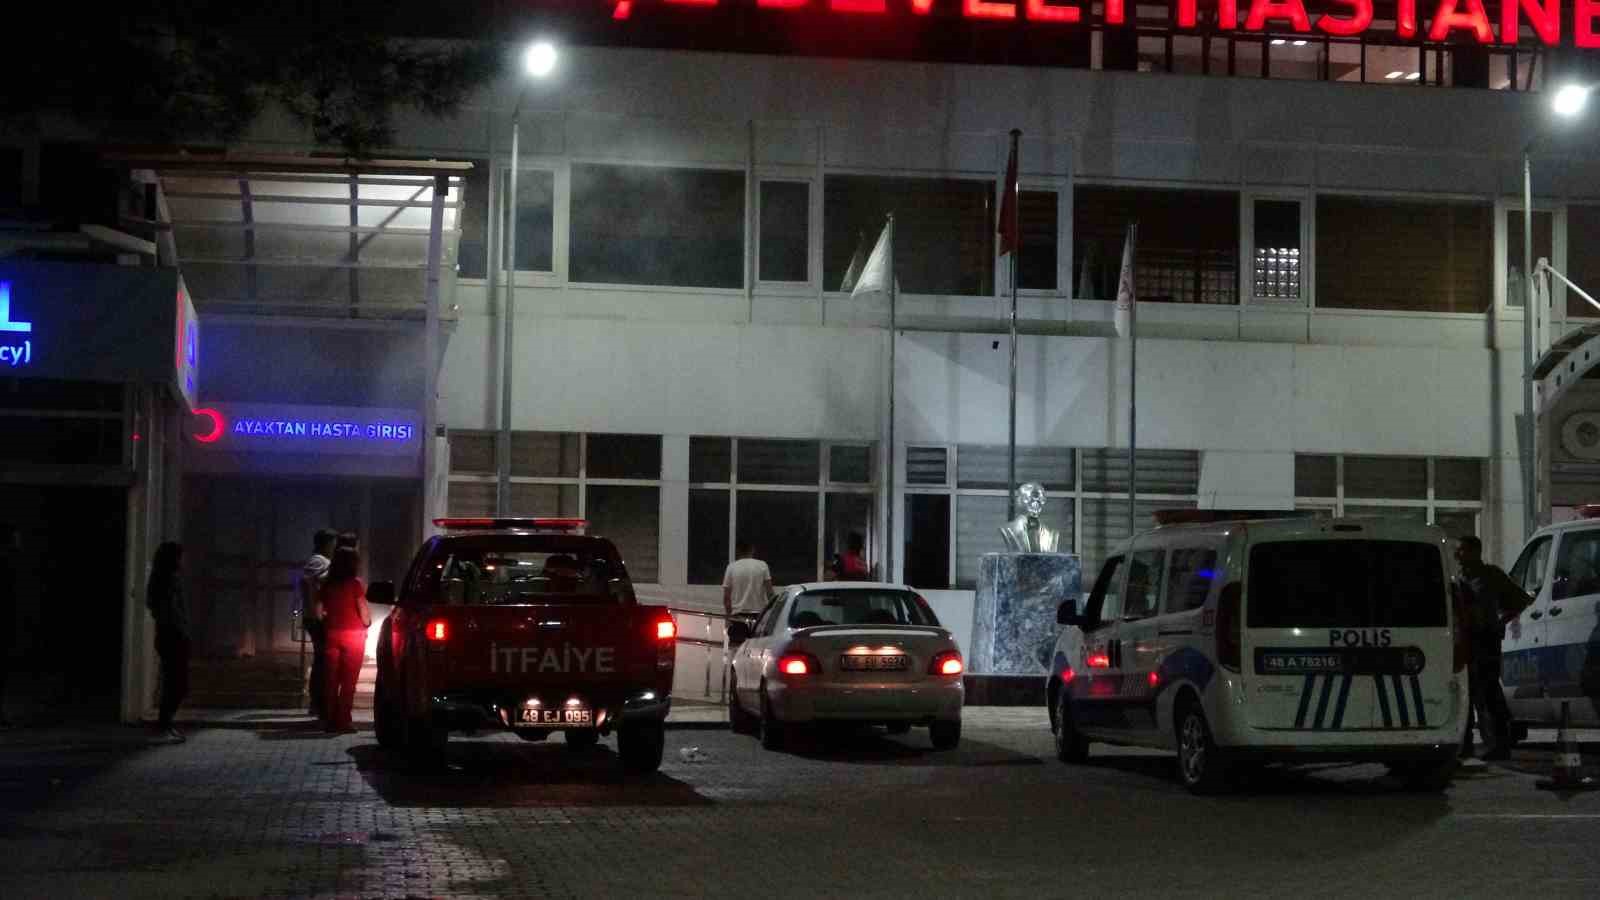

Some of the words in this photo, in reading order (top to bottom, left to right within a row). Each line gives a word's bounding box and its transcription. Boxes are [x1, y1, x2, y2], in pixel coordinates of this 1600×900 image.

[234, 420, 306, 436] AYAKTAN
[311, 422, 361, 438] HASTA
[490, 642, 616, 673] İTFAİYE
[522, 710, 539, 722] 48
[543, 710, 561, 722] EJ
[564, 710, 590, 722] 095
